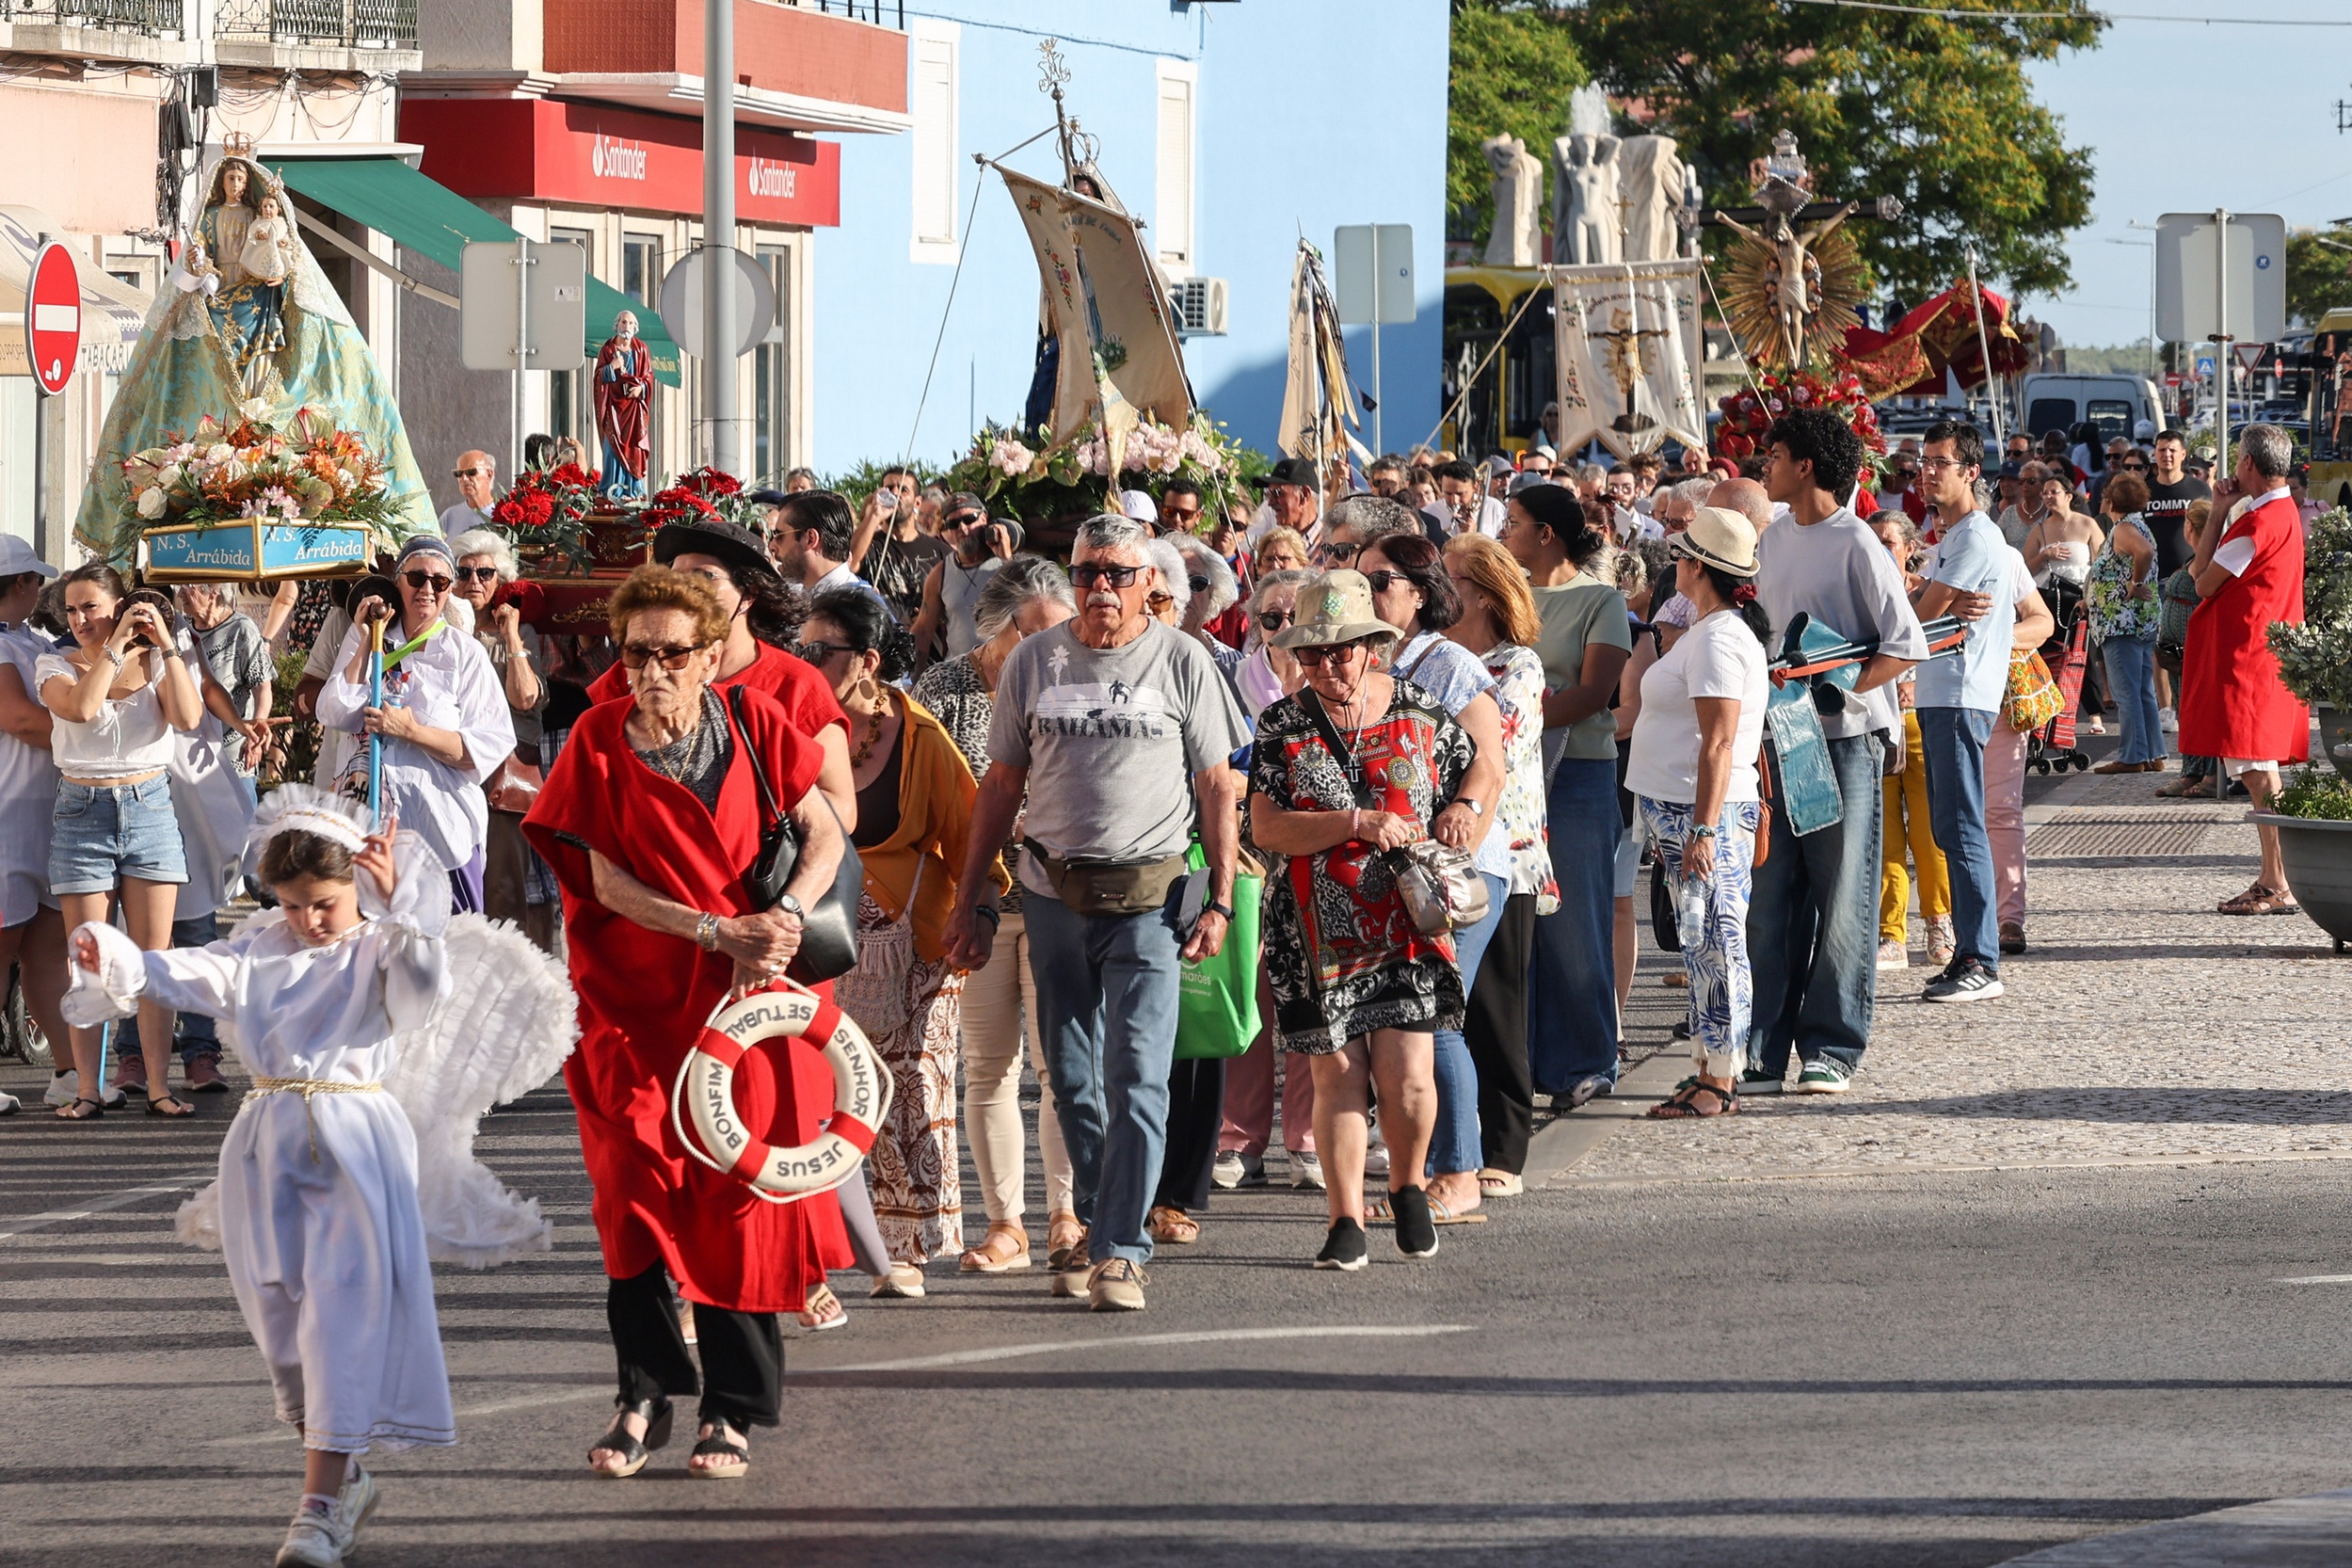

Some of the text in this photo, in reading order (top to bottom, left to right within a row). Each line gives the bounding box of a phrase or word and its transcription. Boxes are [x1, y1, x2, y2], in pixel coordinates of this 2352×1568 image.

[603, 136, 647, 181] Santander
[758, 158, 796, 199] Santander
[2146, 499, 2192, 511] TOMMY
[156, 534, 190, 552] N. S.
[265, 525, 296, 543] N. S.
[184, 548, 251, 567] Arrábida
[294, 540, 363, 561] Arrábida
[1037, 717, 1163, 740] BAHAMAS
[724, 1003, 813, 1039] SETUBAL
[708, 1029, 871, 1177] SENHOR JESUS BONFIM
